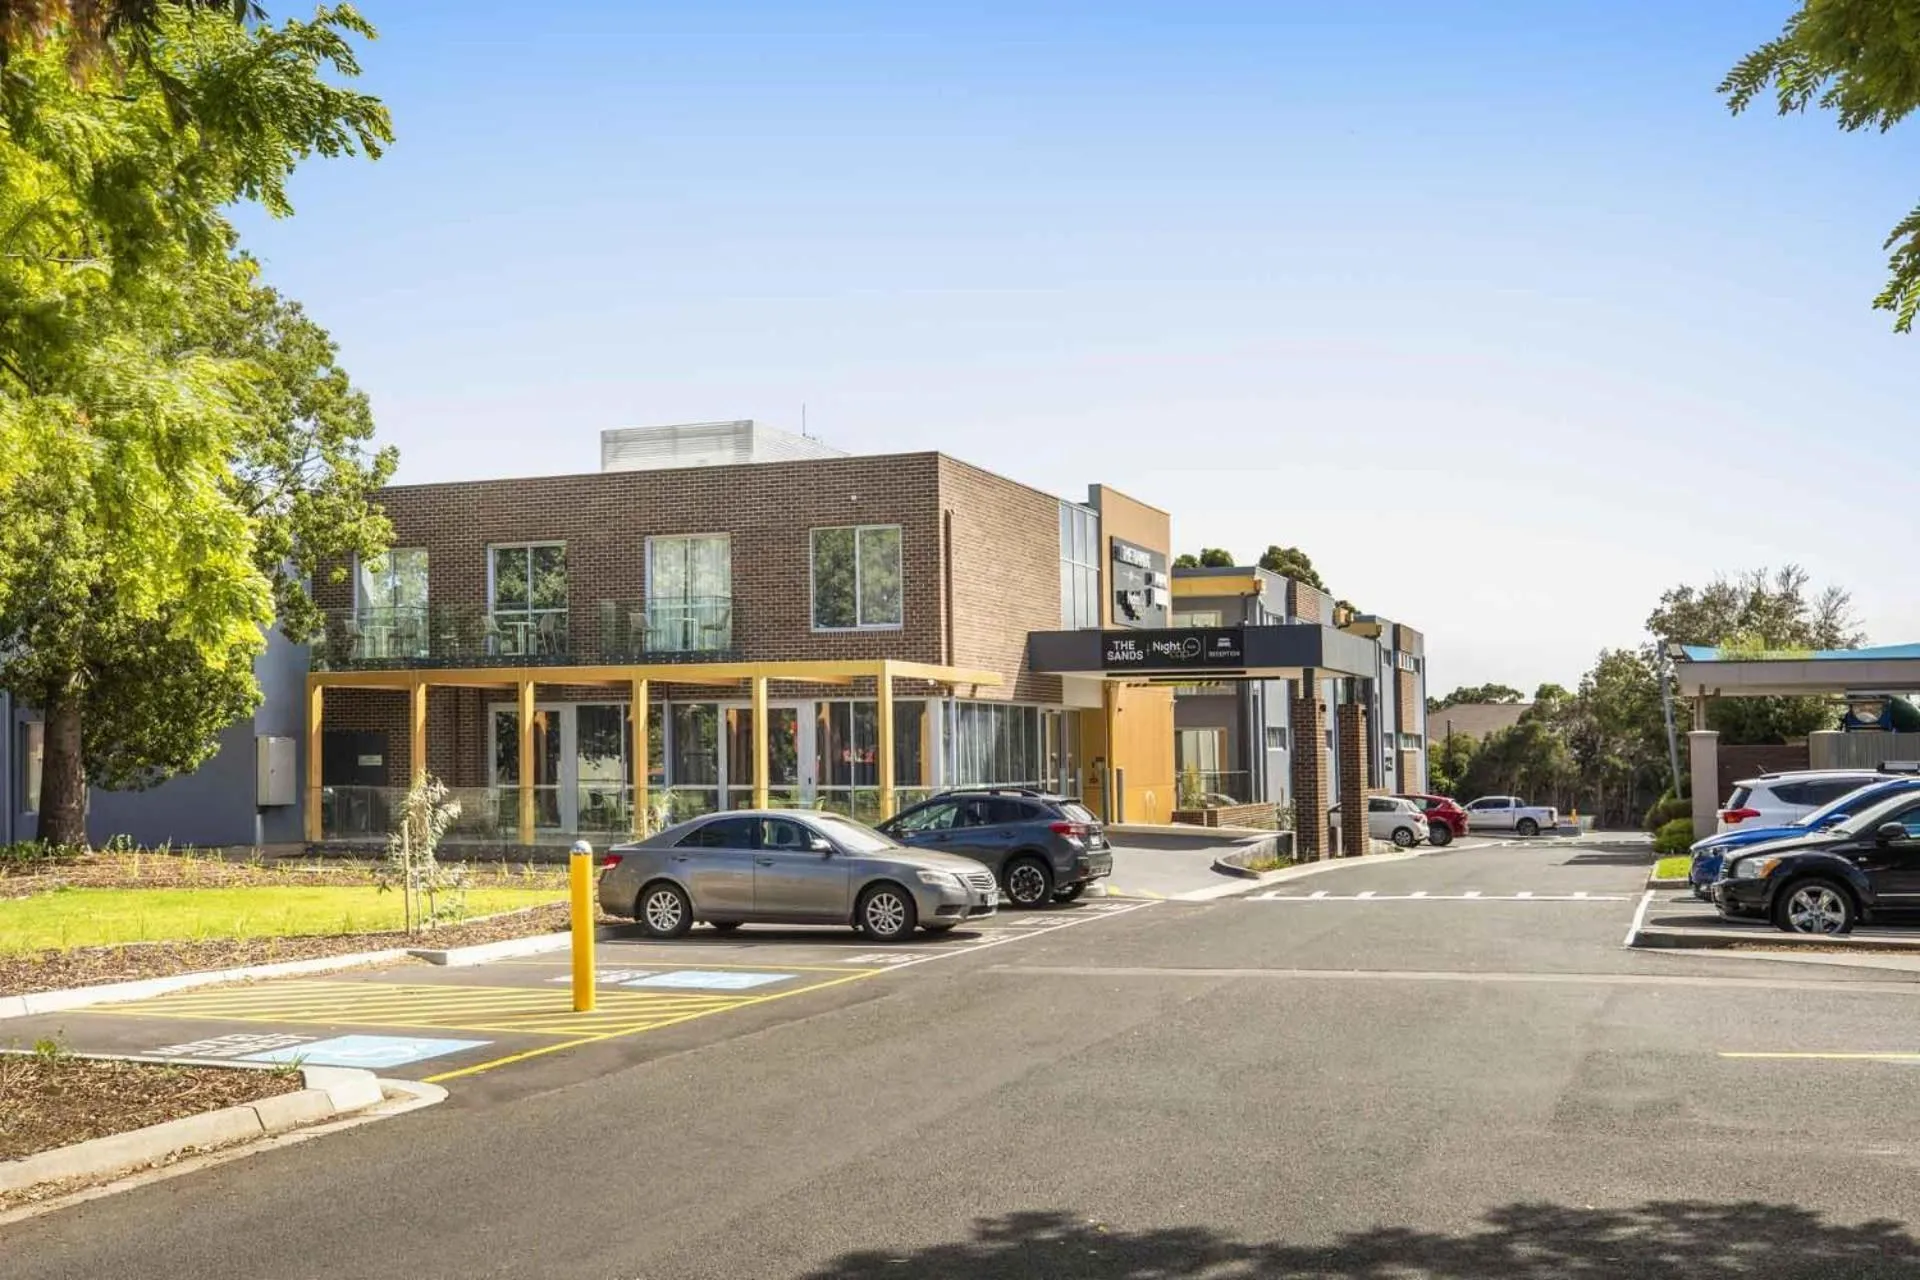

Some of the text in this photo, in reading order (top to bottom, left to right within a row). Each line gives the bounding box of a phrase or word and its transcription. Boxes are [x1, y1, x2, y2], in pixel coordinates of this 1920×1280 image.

[1112, 640, 1136, 650] THE
[1152, 641, 1182, 655] Night
[1106, 651, 1144, 661] SANDS
